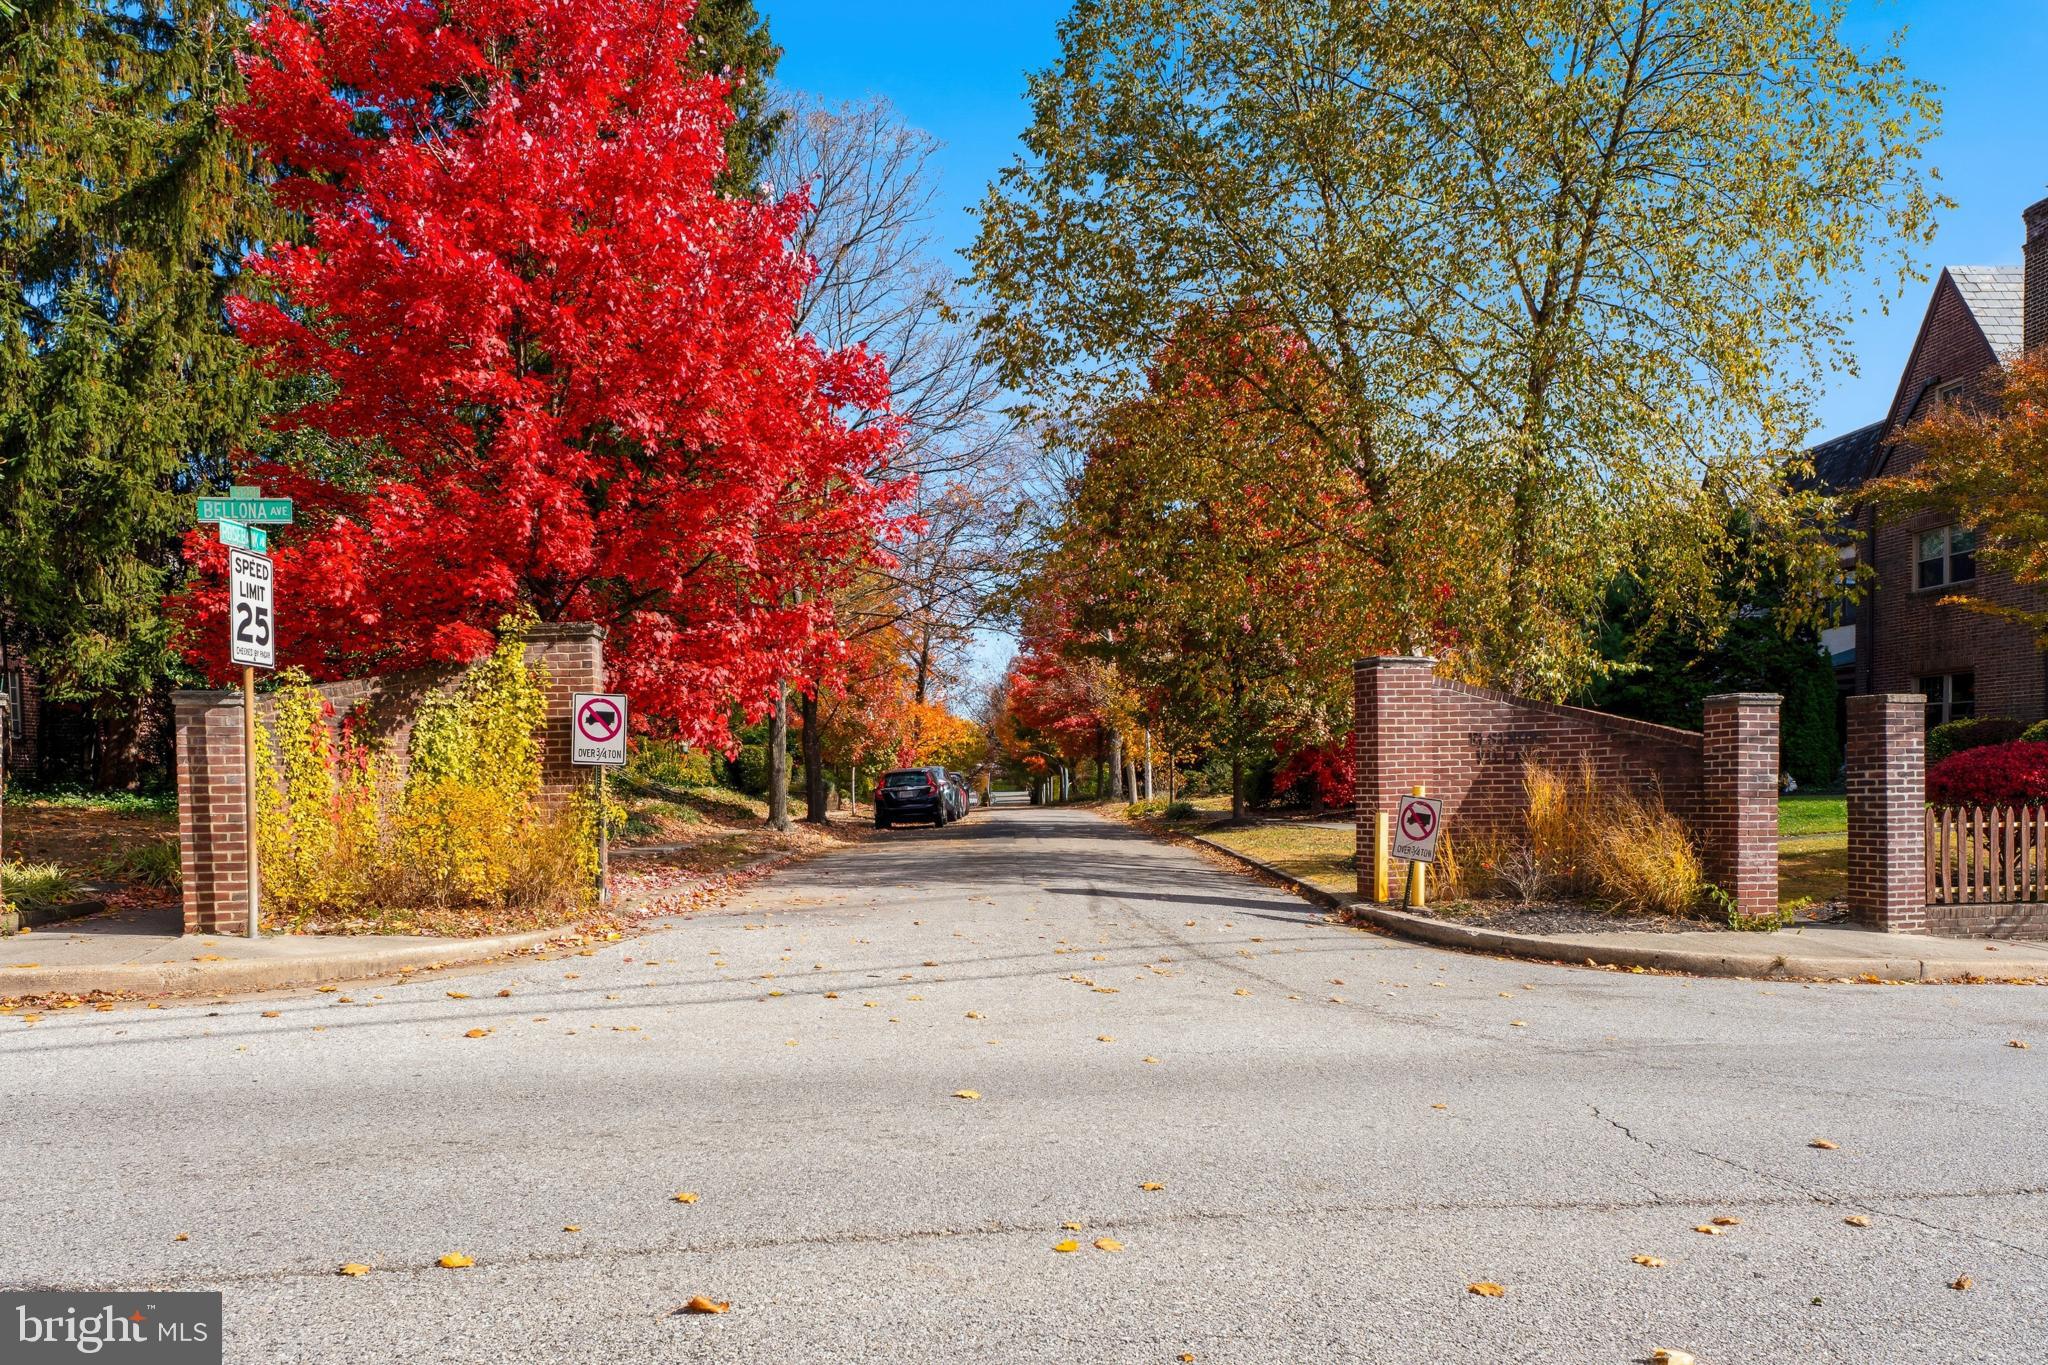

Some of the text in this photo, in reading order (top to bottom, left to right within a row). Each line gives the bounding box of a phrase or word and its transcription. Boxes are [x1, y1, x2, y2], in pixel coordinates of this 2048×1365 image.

[203, 501, 288, 519] BELLONA AVE
[235, 557, 269, 581] SPEED
[240, 580, 266, 602] LIMIT
[236, 602, 270, 647] 25
[578, 748, 595, 758] OVER
[608, 750, 622, 759] TON
[1397, 845, 1411, 855] OVER
